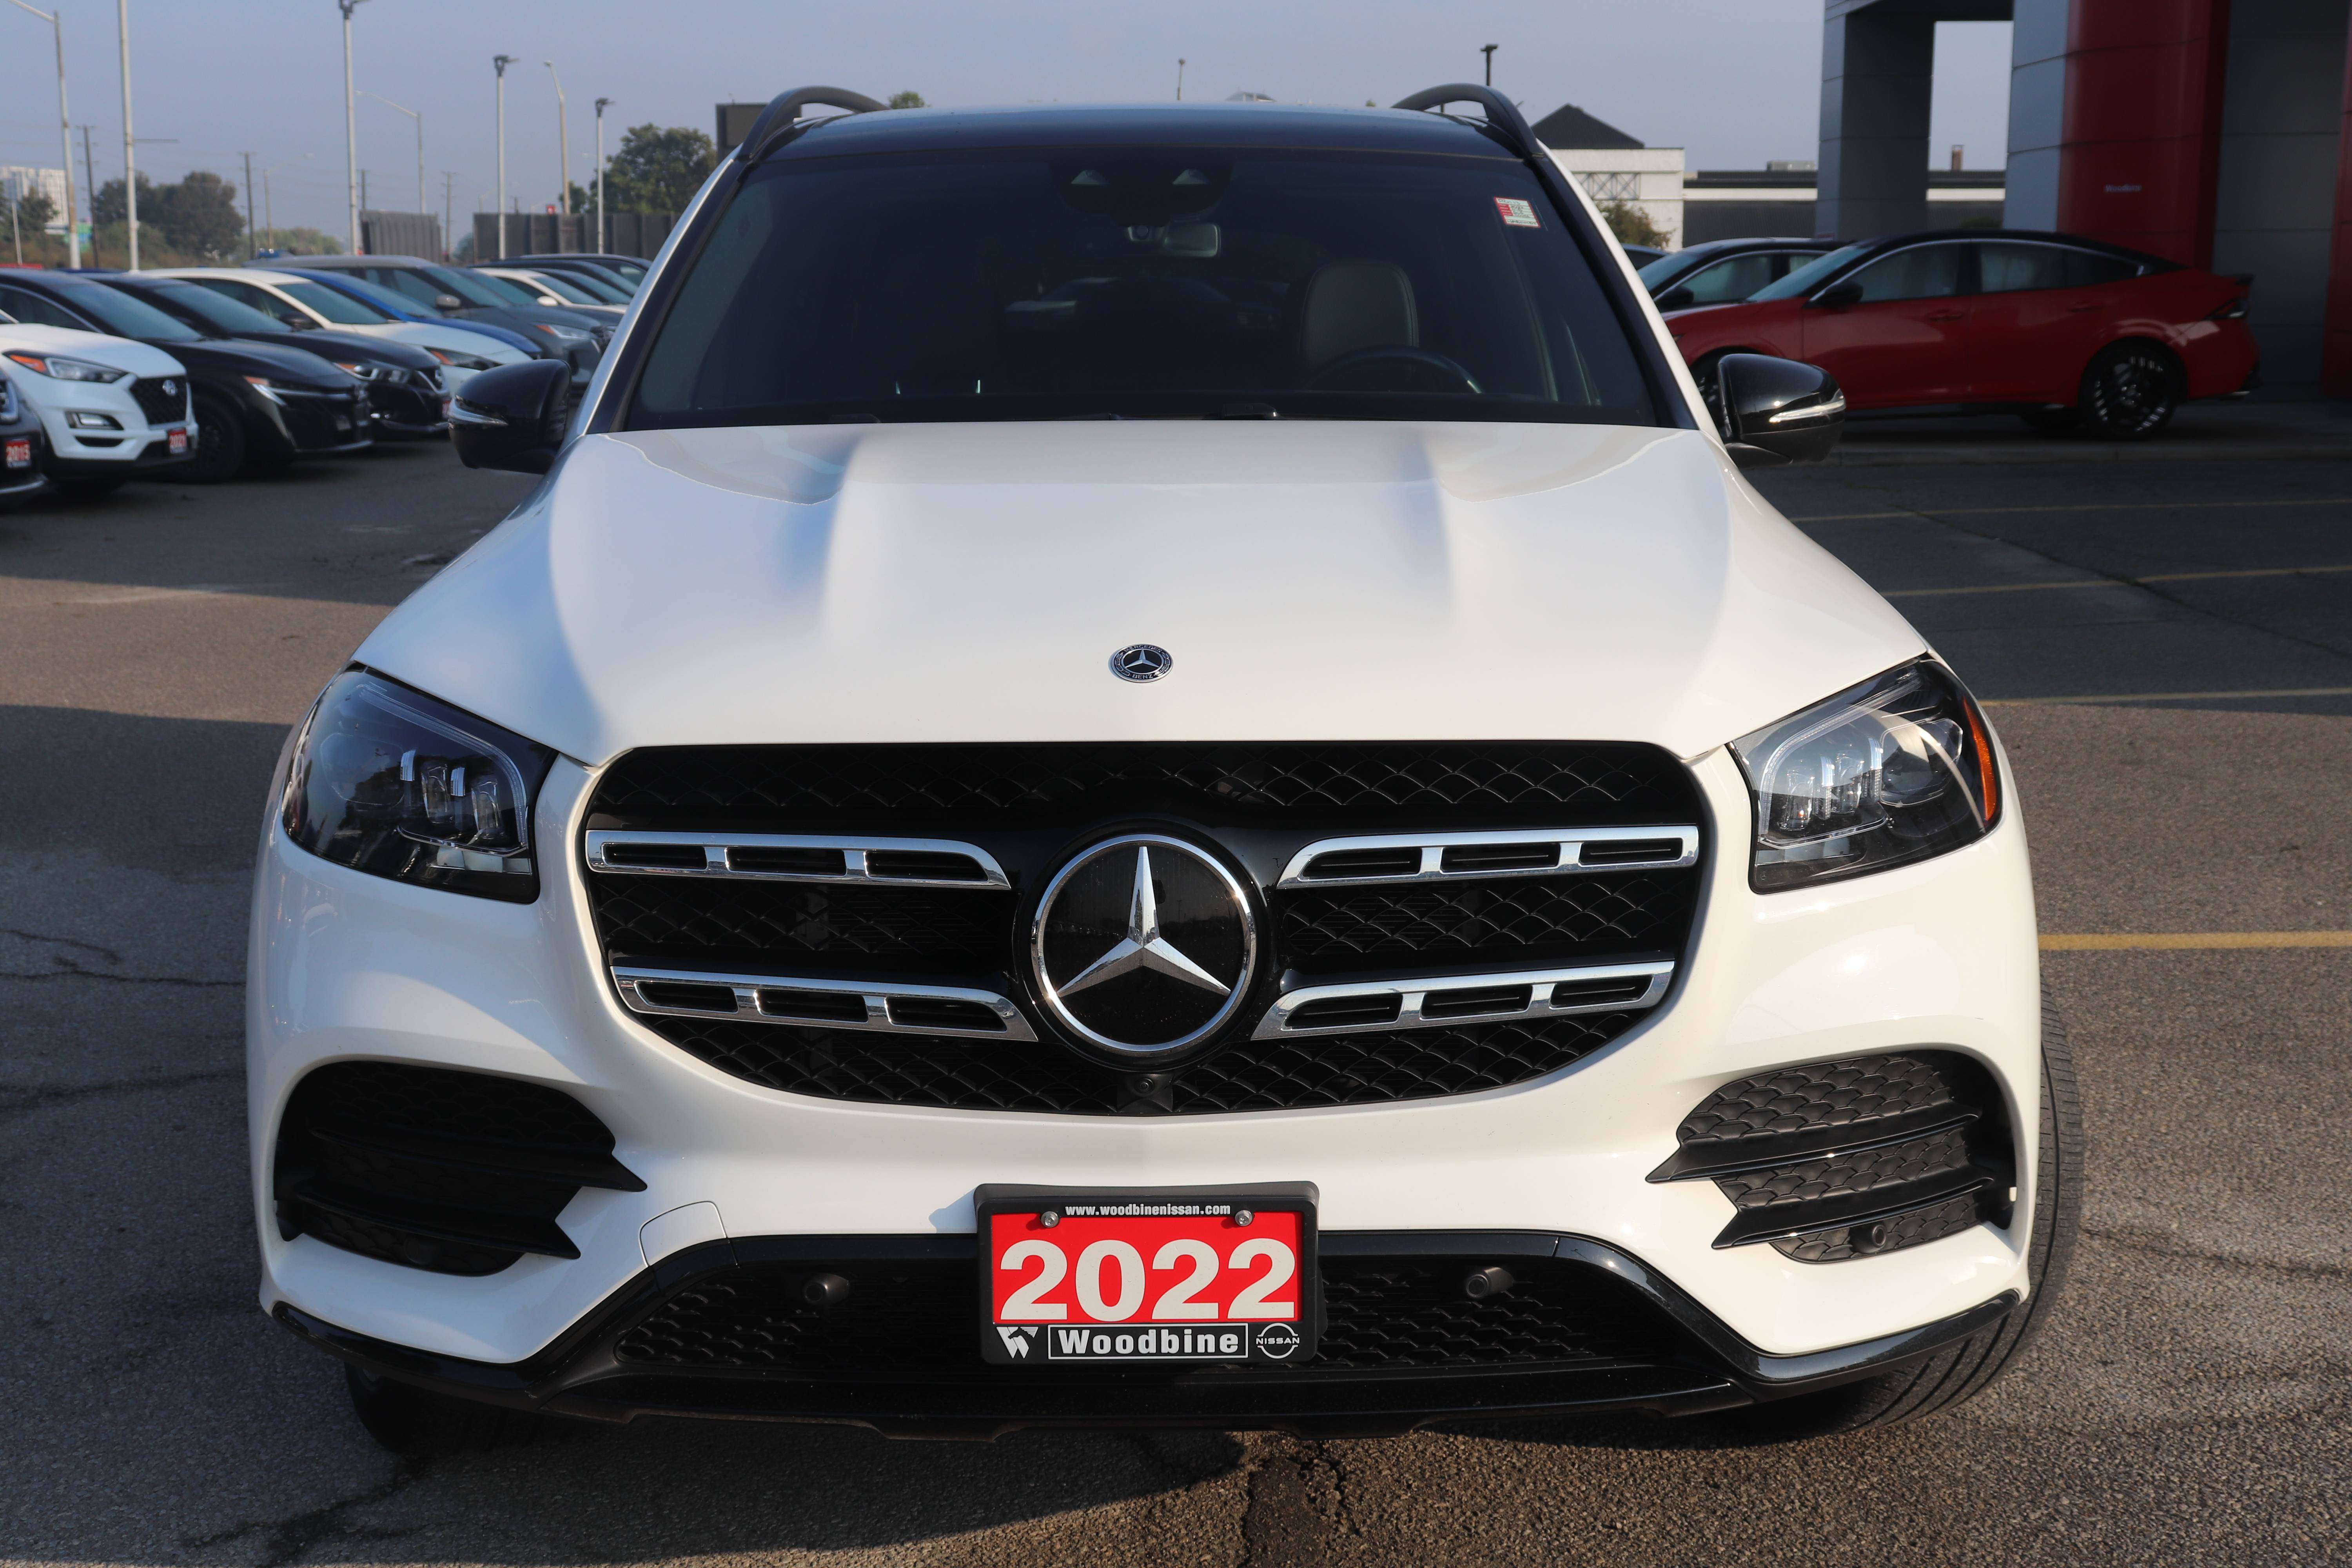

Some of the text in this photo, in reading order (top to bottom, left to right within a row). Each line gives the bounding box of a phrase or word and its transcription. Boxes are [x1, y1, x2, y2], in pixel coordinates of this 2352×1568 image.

[1065, 1203, 1231, 1216] www.woodbinenissan.com
[1000, 1238, 1296, 1322] 2022
[1058, 1328, 1239, 1355] Woodbine
[1256, 1337, 1300, 1346] NISSAN
